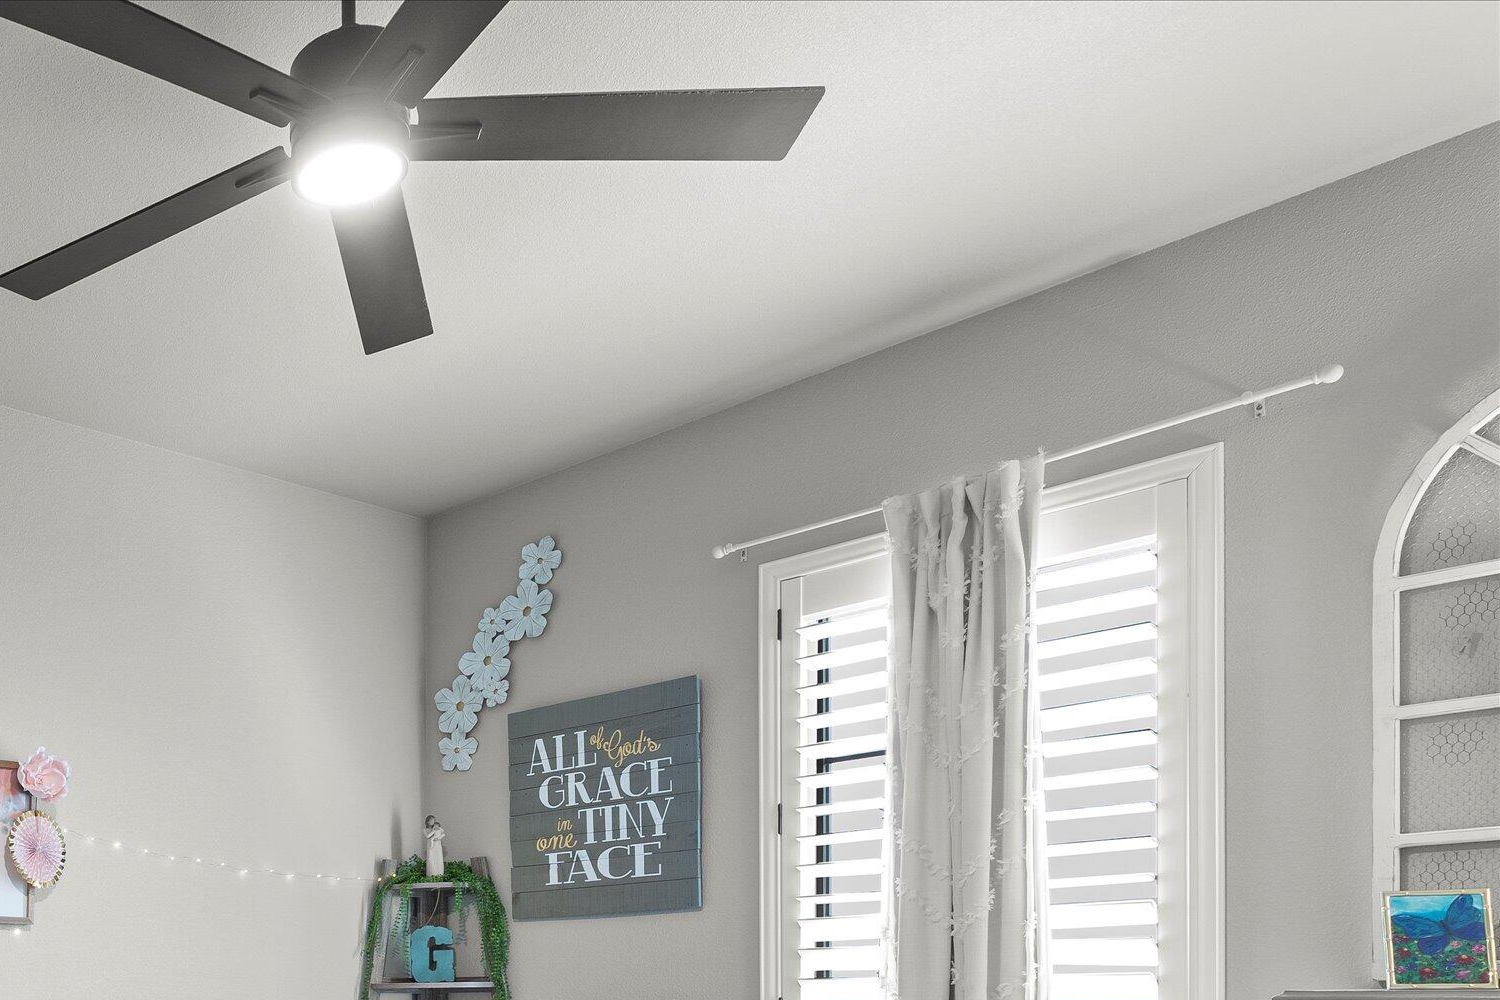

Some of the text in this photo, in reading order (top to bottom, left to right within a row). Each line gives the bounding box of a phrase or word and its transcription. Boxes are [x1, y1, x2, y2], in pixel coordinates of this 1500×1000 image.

[526, 726, 661, 776] ALL of God's
[538, 756, 673, 809] GRACE
[536, 832, 578, 851] one
[556, 797, 675, 845] in TINY
[544, 841, 662, 886] FACE
[410, 925, 455, 982] G
